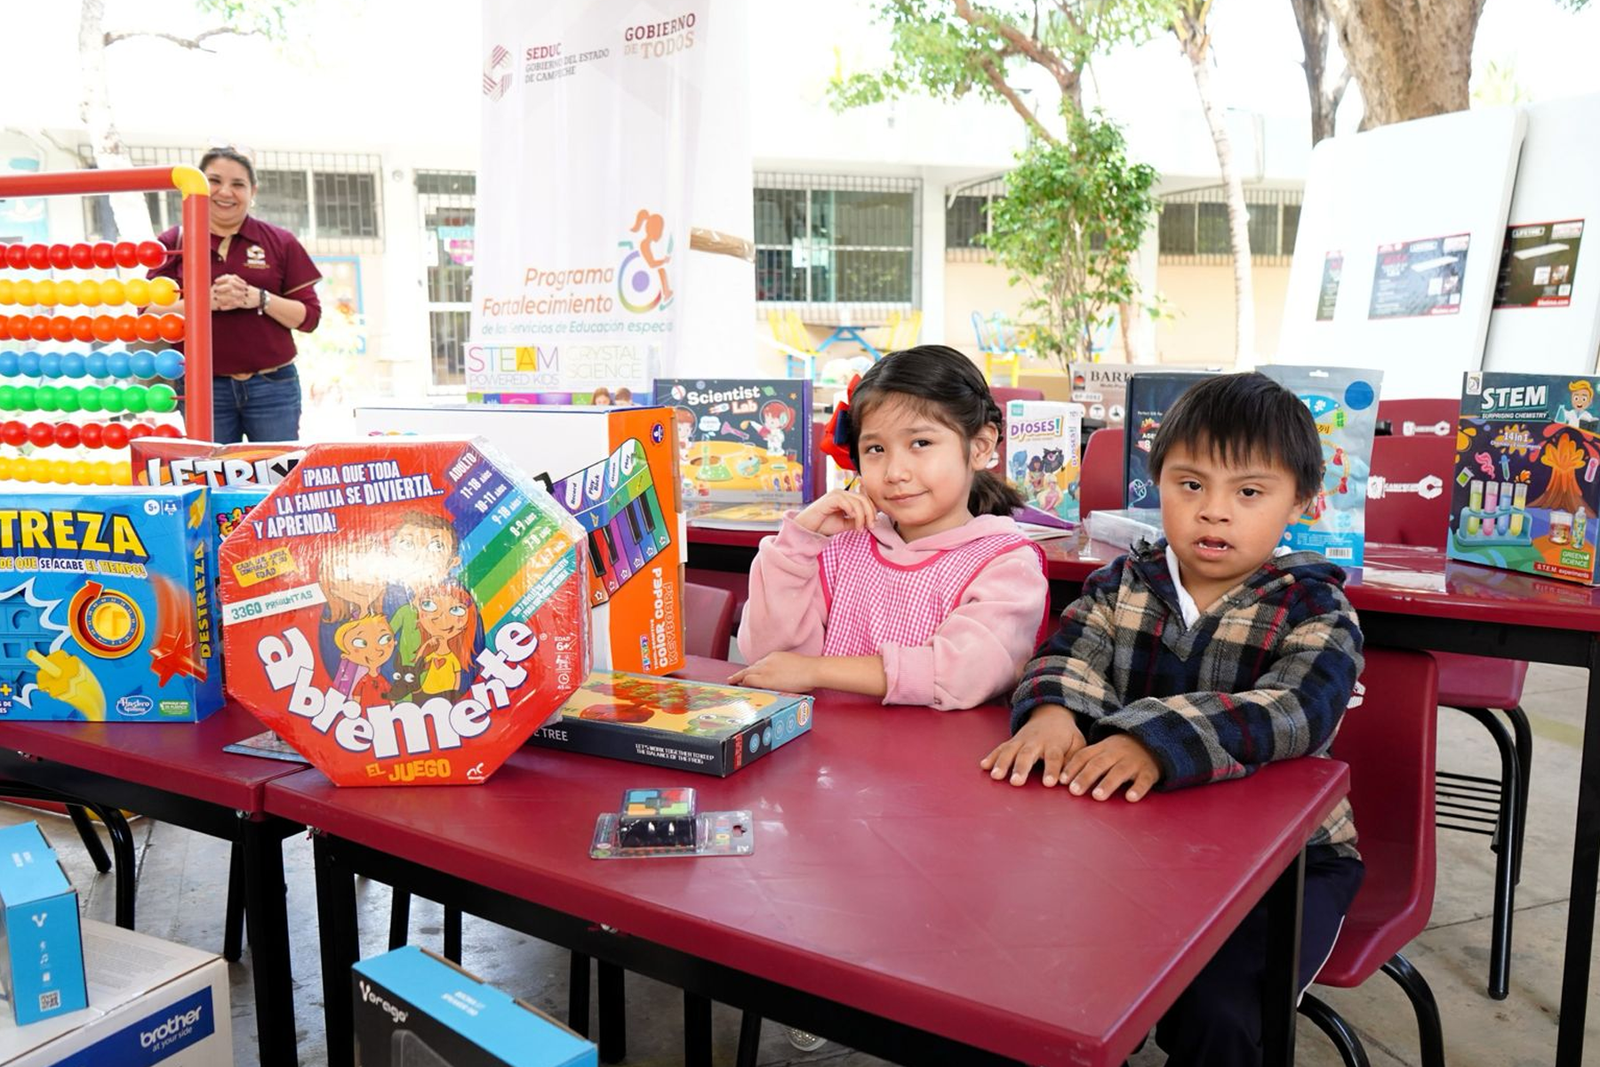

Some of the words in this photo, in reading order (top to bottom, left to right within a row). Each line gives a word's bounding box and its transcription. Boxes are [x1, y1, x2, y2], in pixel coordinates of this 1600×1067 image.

[624, 13, 696, 42] GOBIERNO
[526, 43, 562, 60] SEDUC
[624, 45, 638, 57] DE
[641, 31, 695, 60] TODOS
[525, 57, 563, 73] GOBIERNO
[564, 54, 577, 66] DEL
[579, 48, 610, 64] ESTADO
[525, 73, 535, 84] DE
[536, 65, 576, 83] CAMPECHE
[524, 267, 614, 291] Programa
[482, 293, 613, 317] Fortalecimiento
[482, 325, 493, 335] de
[468, 346, 560, 373] STEAM
[566, 345, 642, 361] CRYSTAL
[469, 374, 530, 387] POWERED
[566, 364, 642, 380] SCIENCE
[687, 386, 761, 406] Scientist
[732, 400, 758, 414] Lab
[1481, 385, 1547, 410] STEM
[1010, 417, 1061, 437] DIOSES!
[1482, 412, 1514, 420] SURPRISING
[342, 465, 367, 484] QUE
[367, 460, 401, 481] TODA
[448, 452, 477, 482] ADULTO
[276, 496, 294, 515] LA
[296, 489, 345, 512] FAMILIA
[347, 486, 363, 505] SE
[253, 521, 264, 540] Y
[267, 512, 338, 540] APRENDA!
[16, 556, 37, 569] QUE
[40, 559, 51, 570] SE
[53, 560, 84, 571] ACABE
[86, 560, 98, 572] EL
[100, 561, 148, 577] TIEMPO!
[194, 542, 212, 659] DESTREZA
[231, 602, 262, 621] 3360
[265, 590, 313, 611] PREGUNTAS
[541, 727, 569, 742] TREE
[367, 765, 386, 778] EL
[389, 758, 451, 783] JUEGO
[140, 1005, 202, 1048] brother
[152, 1043, 160, 1052] at
[161, 1034, 177, 1050] your
[179, 1026, 193, 1039] side
